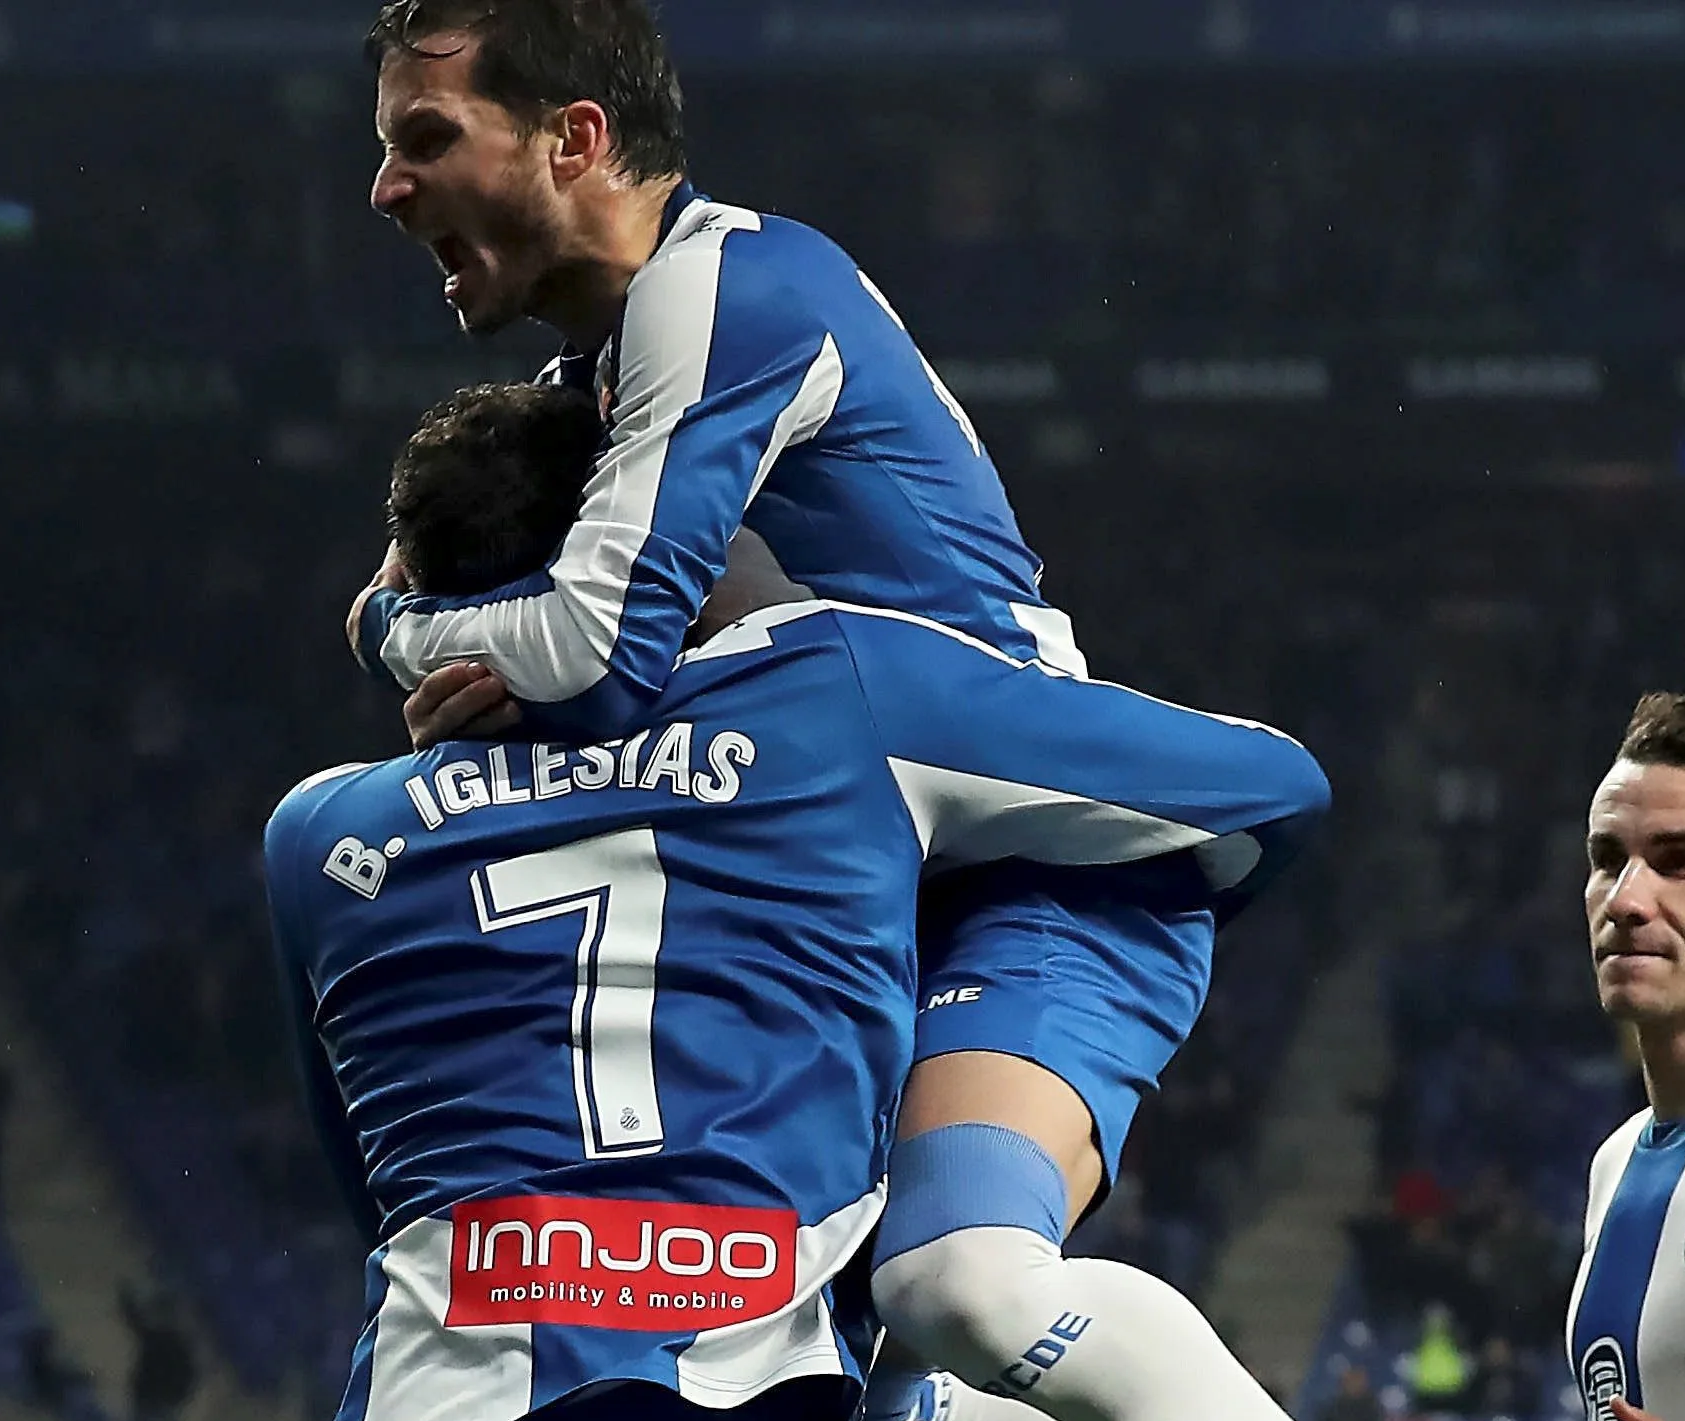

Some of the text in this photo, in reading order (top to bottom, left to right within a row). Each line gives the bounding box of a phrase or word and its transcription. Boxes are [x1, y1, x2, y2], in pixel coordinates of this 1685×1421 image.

[322, 722, 757, 900] B. IGLESIAS
[469, 825, 668, 1160] 7
[491, 1281, 746, 1310] mobility & mobile
